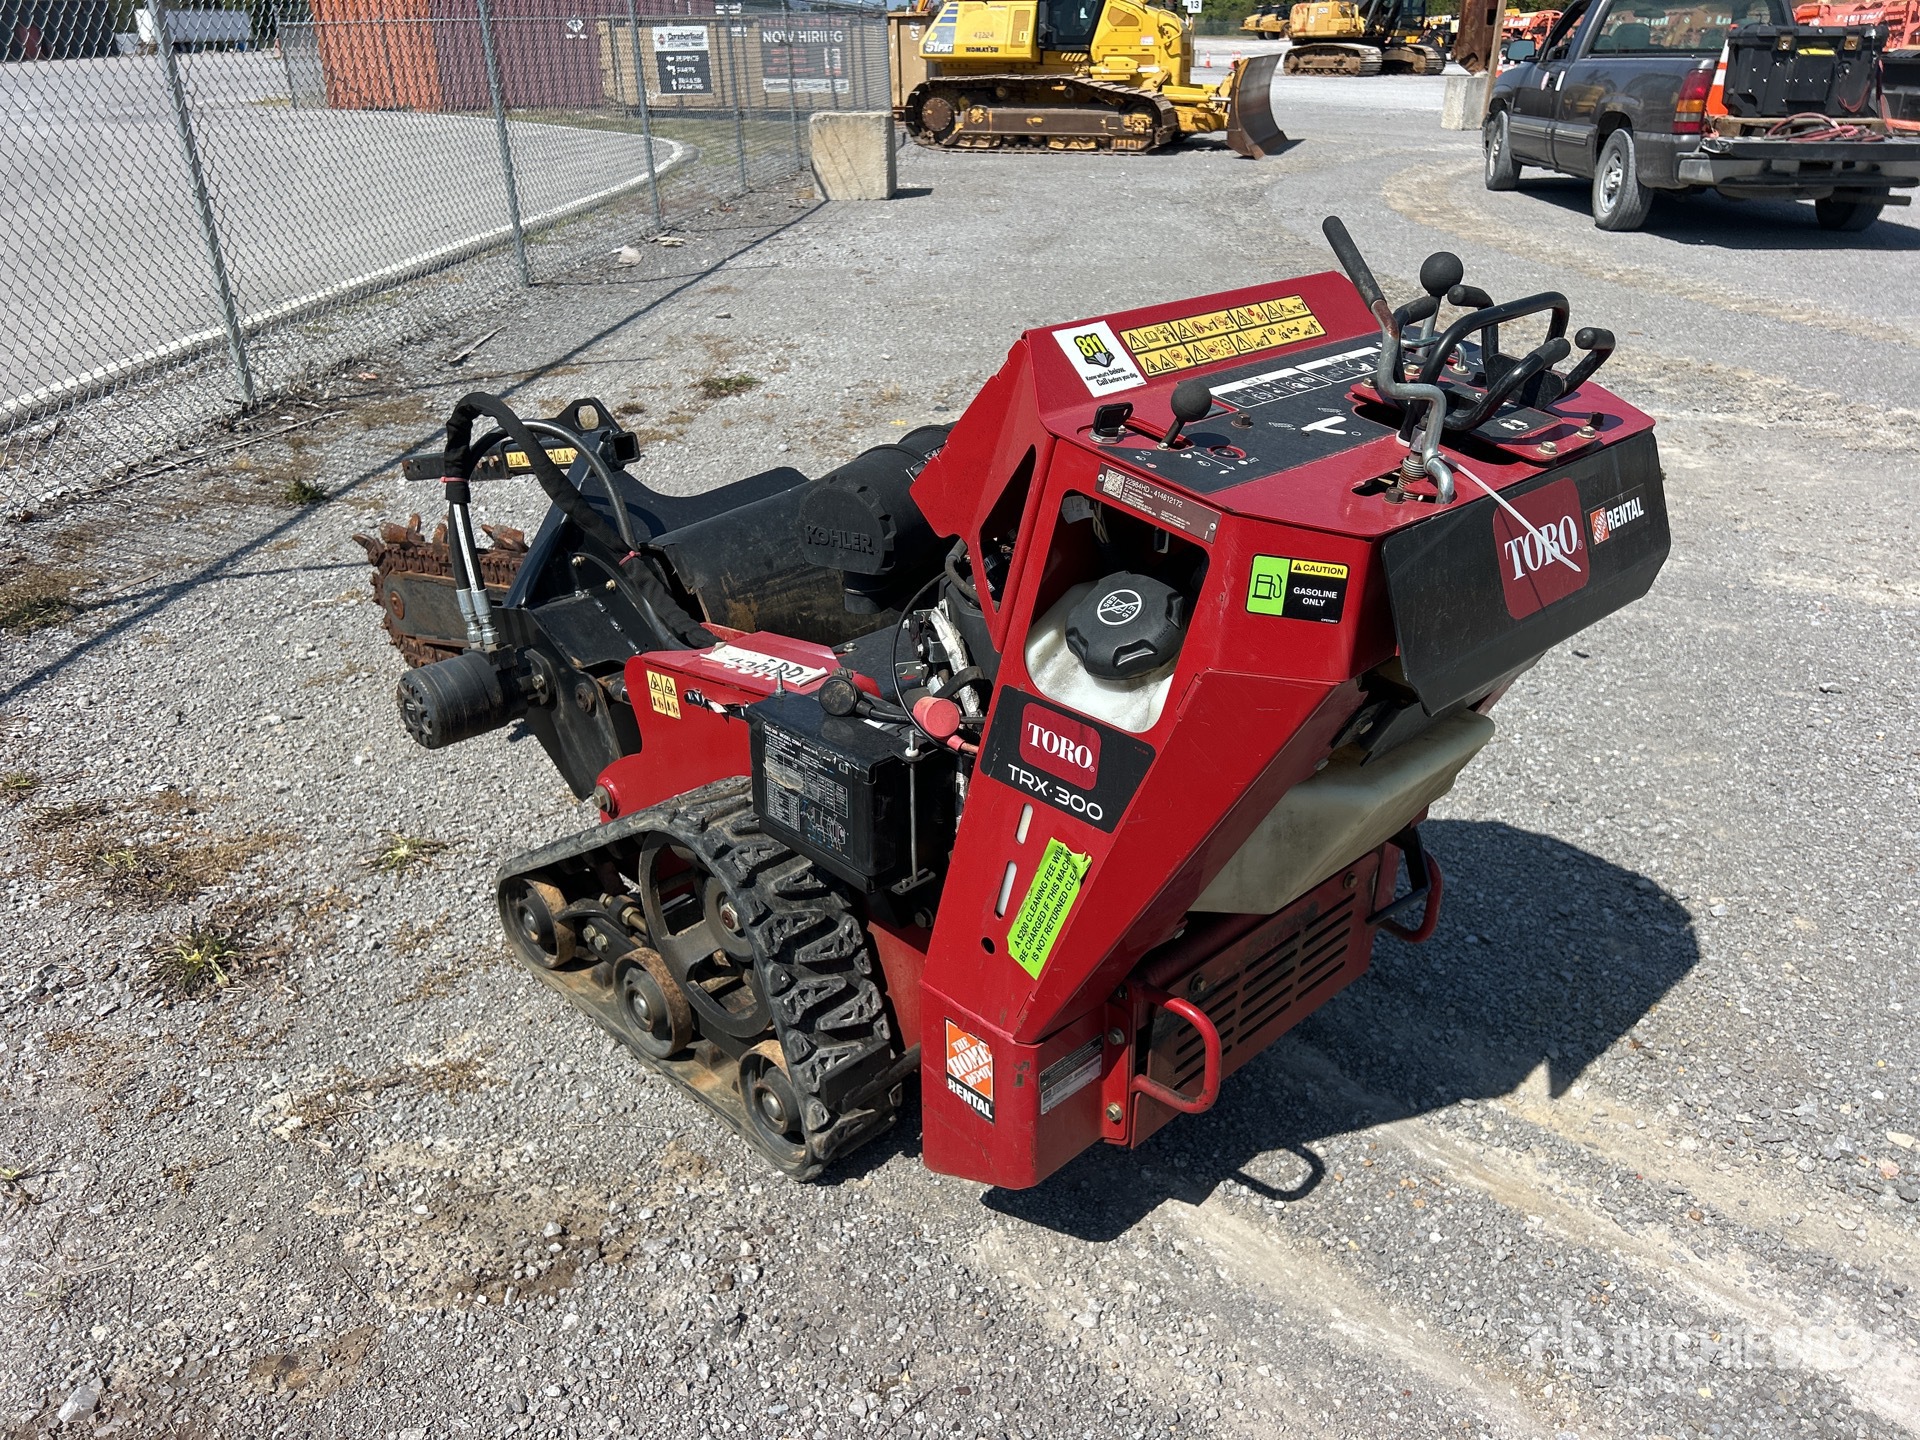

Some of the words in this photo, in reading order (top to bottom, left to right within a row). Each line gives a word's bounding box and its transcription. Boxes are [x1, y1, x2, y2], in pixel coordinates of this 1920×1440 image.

[1190, 0, 1200, 9] 13
[762, 30, 795, 43] NOW
[1074, 333, 1109, 357] 811
[1096, 378, 1109, 386] Call
[1606, 496, 1645, 532] RENTAL
[805, 525, 876, 556] KOHLER
[1504, 515, 1579, 581] TORO
[1303, 564, 1344, 575] CAUTION
[1103, 595, 1118, 609] E85
[1293, 586, 1338, 599] GASOLINE
[1302, 597, 1326, 607] ONLY
[1121, 604, 1136, 619] E15
[1028, 722, 1093, 770] TORO
[1014, 940, 1021, 949] A
[1018, 921, 1030, 942] $200
[1025, 880, 1048, 923] CLEANING
[1044, 863, 1057, 882] FEE
[1052, 845, 1064, 864] WILL
[1019, 948, 1029, 963] BE
[1025, 910, 1047, 950] CHARGED
[1042, 901, 1051, 912] IF
[1047, 882, 1060, 903] THIS
[1031, 953, 1040, 963] IS
[1036, 934, 1048, 954] NOT
[1044, 890, 1068, 936] RETURNED
[951, 1036, 971, 1053] THE
[948, 1042, 991, 1078] HOME
[964, 1064, 992, 1087] DEPOT
[947, 1077, 993, 1120] RENTAL
